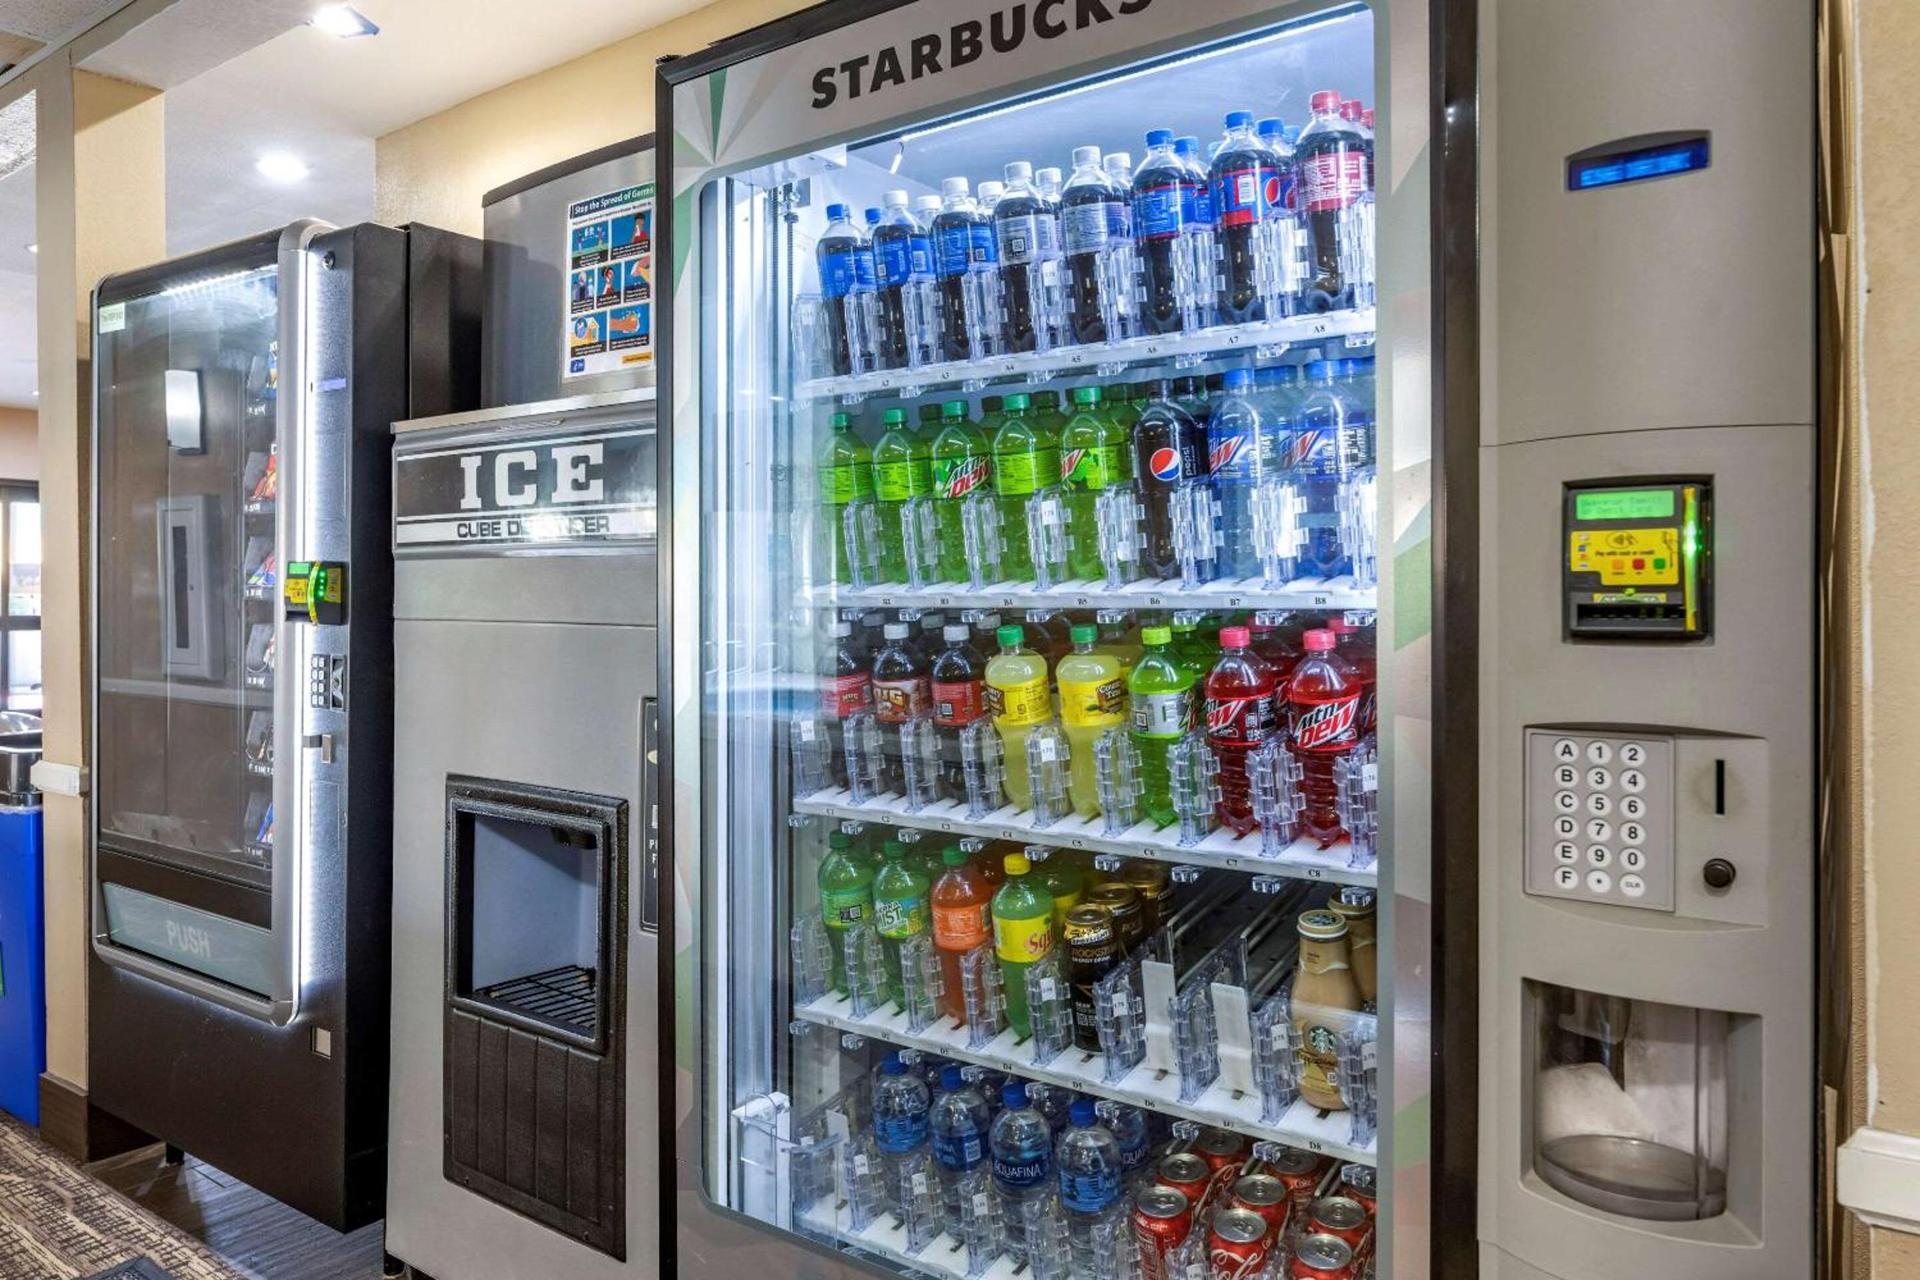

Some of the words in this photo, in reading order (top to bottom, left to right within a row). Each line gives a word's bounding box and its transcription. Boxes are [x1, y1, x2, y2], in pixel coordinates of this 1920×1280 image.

[590, 201, 599, 209] the
[600, 193, 623, 208] Spread
[624, 191, 632, 200] of
[632, 187, 654, 198] Germs
[460, 442, 604, 510] ICE
[457, 519, 501, 538] CUBE
[1561, 744, 1573, 757] A
[1597, 746, 1603, 758] 1
[1628, 748, 1639, 761] 2
[1562, 769, 1573, 782] B
[1595, 772, 1604, 785] 3
[1628, 774, 1639, 787] 4
[1561, 795, 1573, 808] C
[1595, 798, 1604, 811] 5
[1628, 800, 1639, 813] 6
[1561, 820, 1573, 833] D
[1595, 823, 1604, 836] 7
[1628, 827, 1638, 839] 8
[1562, 846, 1572, 858] E
[1595, 849, 1604, 862] 9
[1628, 852, 1638, 866] 0
[1308, 869, 1321, 878] C8
[1562, 871, 1572, 883] F
[166, 919, 211, 958] PUSH
[994, 1160, 1042, 1178] AQUAFINA
